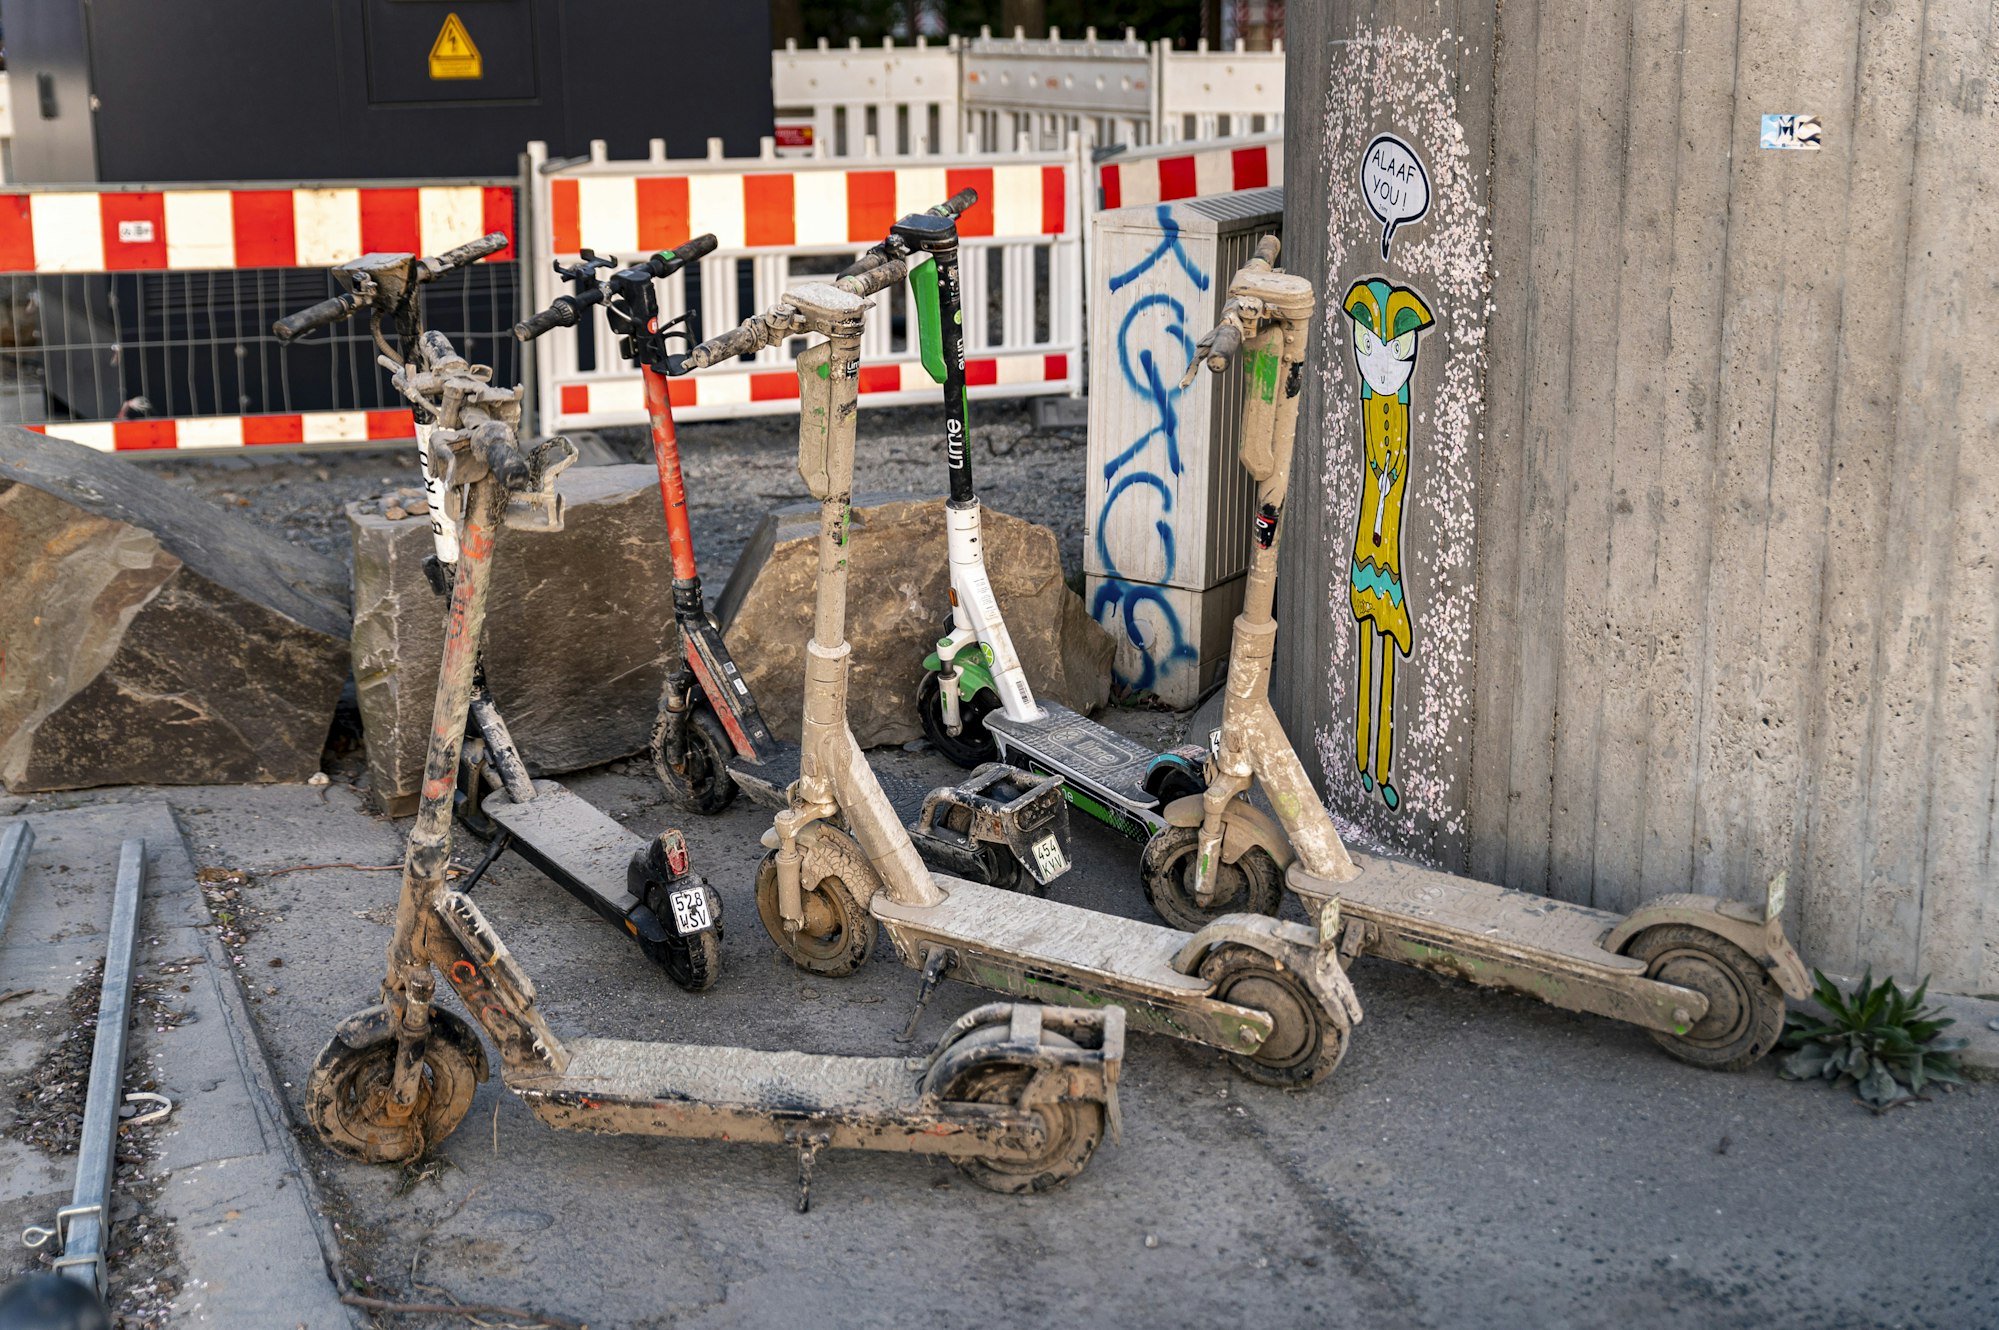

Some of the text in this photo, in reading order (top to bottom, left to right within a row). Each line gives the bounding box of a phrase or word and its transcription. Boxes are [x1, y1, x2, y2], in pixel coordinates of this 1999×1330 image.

[1372, 149, 1416, 184] ALAAF
[1038, 840, 1057, 860] 454
[675, 892, 703, 911] 528
[679, 909, 706, 928] WSV
